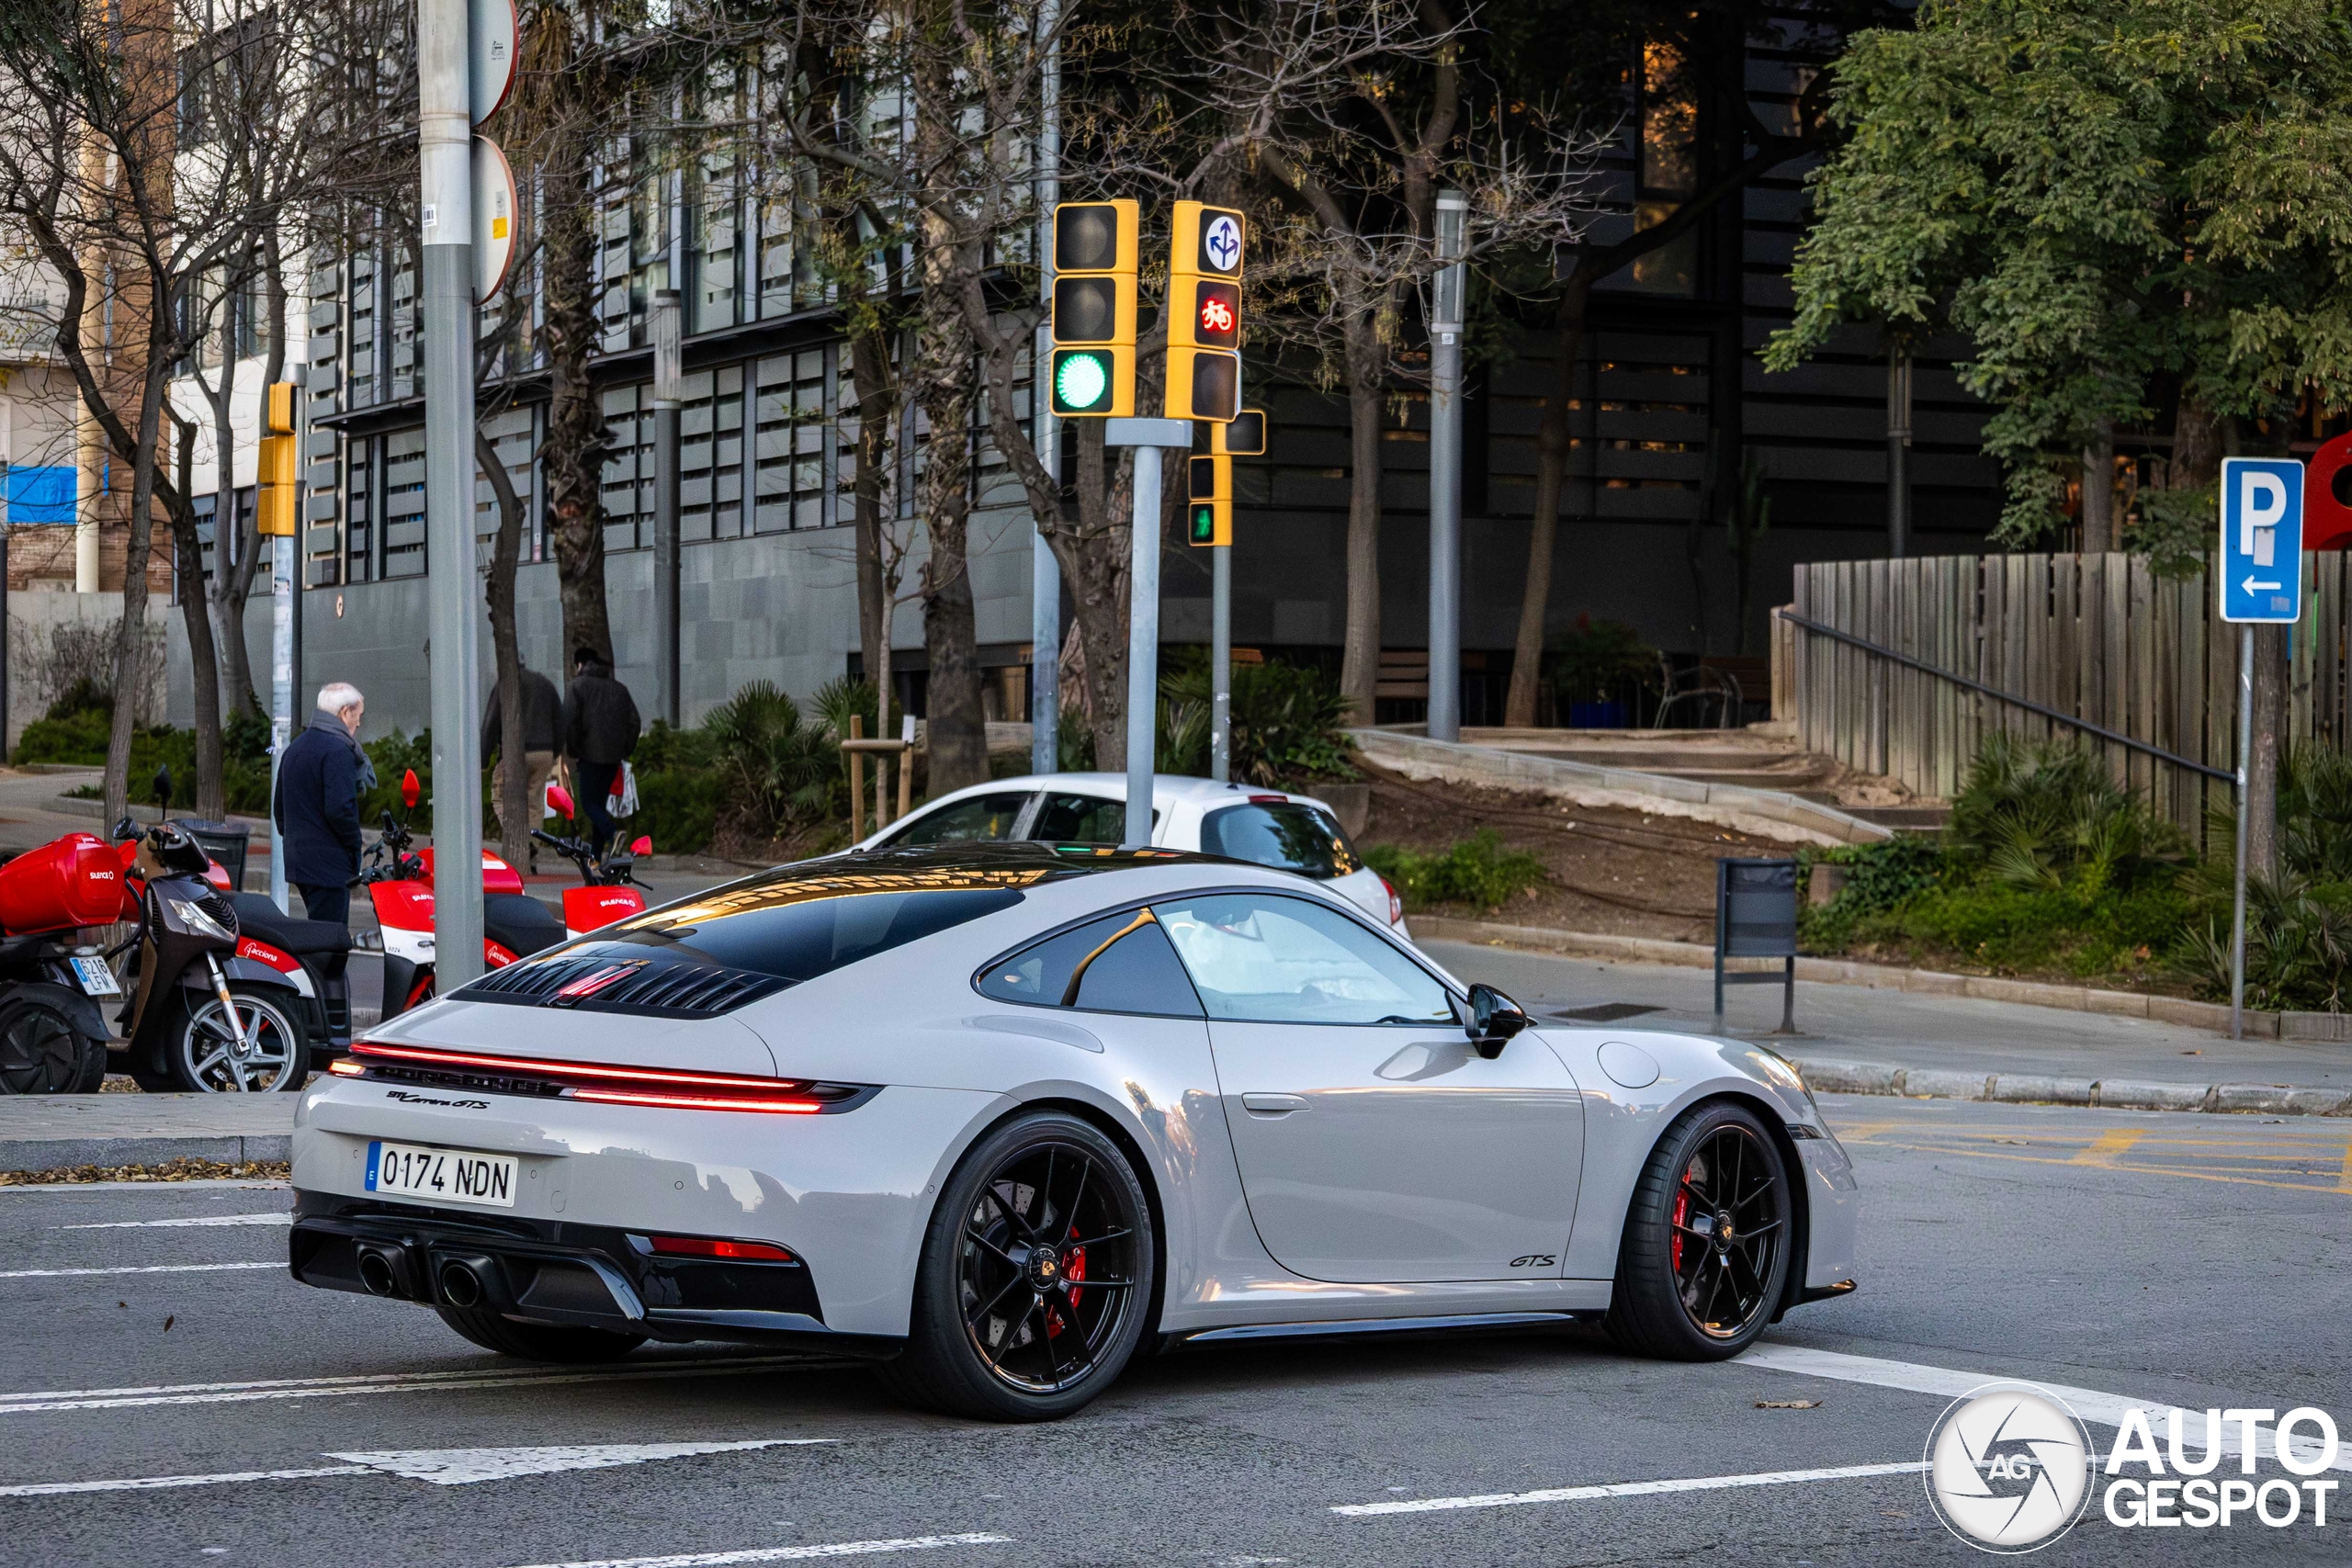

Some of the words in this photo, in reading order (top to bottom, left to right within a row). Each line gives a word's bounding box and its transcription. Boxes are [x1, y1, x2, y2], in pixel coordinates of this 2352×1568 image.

[2240, 471, 2288, 556] P
[251, 947, 278, 963] acciona
[80, 959, 108, 975] 6216
[451, 1100, 492, 1110] GTS
[383, 1150, 445, 1192] 0174
[455, 1158, 510, 1200] NDN
[1510, 1254, 1557, 1268] GTS
